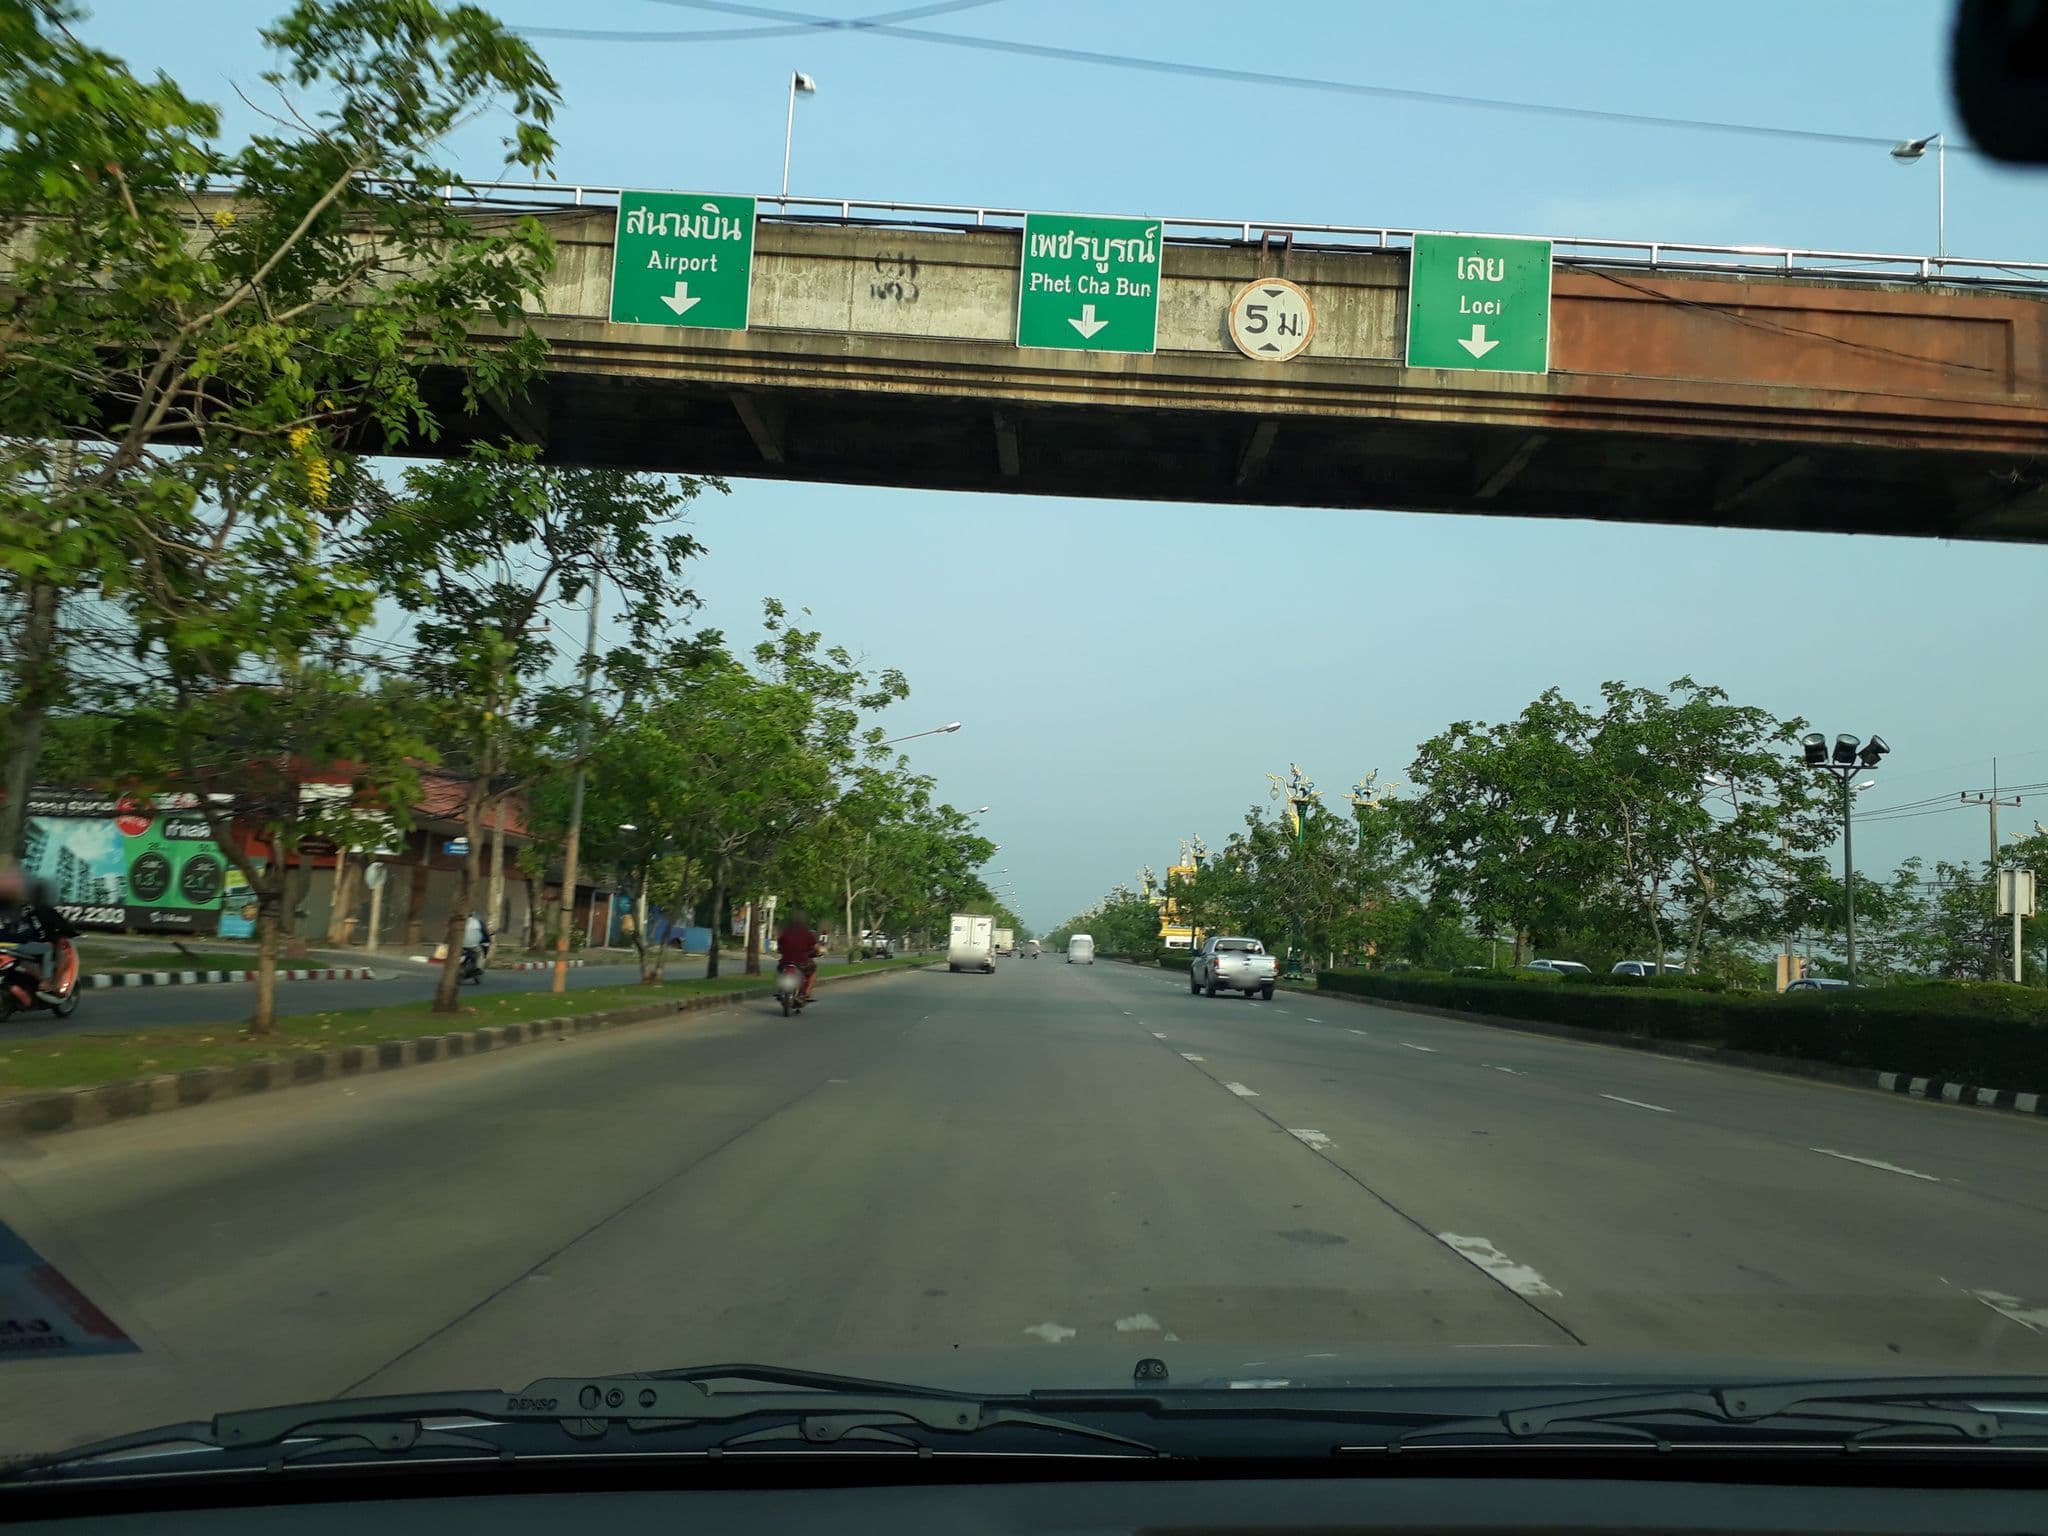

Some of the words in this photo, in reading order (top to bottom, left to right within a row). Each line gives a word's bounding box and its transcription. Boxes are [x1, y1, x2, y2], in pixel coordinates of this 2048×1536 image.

[626, 203, 742, 241] สนามบิน
[647, 250, 718, 274] Airport
[1030, 225, 1158, 274] เพชรบูรณ์
[1457, 256, 1504, 282] เลย
[1029, 273, 1072, 294] Phet
[1077, 275, 1110, 295] Cha
[1115, 277, 1152, 297] Bun
[1459, 295, 1501, 315] Loei
[1245, 304, 1268, 334] 5
